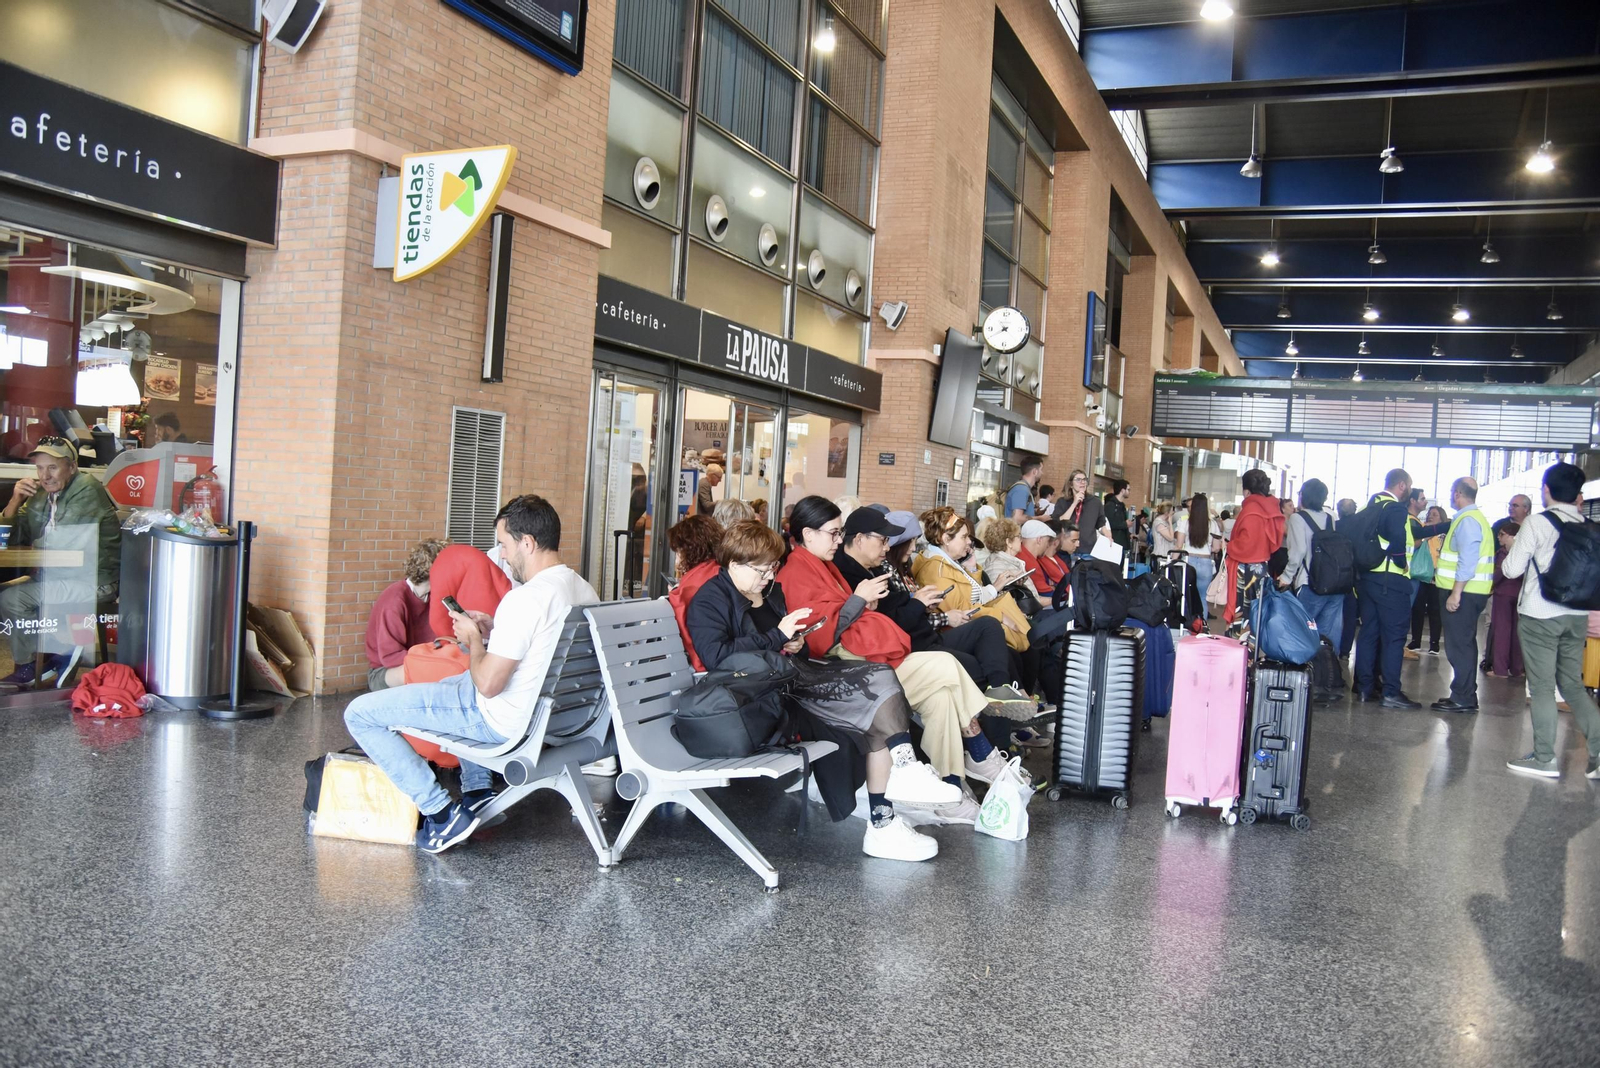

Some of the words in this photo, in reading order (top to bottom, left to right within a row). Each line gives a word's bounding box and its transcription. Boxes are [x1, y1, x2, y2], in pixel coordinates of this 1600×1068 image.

[11, 113, 160, 179] afetería
[426, 162, 435, 211] estación
[403, 164, 424, 264] tiendas
[423, 216, 432, 225] la
[422, 228, 431, 242] de
[602, 300, 659, 330] cafetería
[726, 332, 740, 362] LA
[741, 329, 789, 385] PAUSA
[694, 421, 718, 431] BURGER
[16, 618, 58, 629] tiendas
[99, 613, 119, 623] tien
